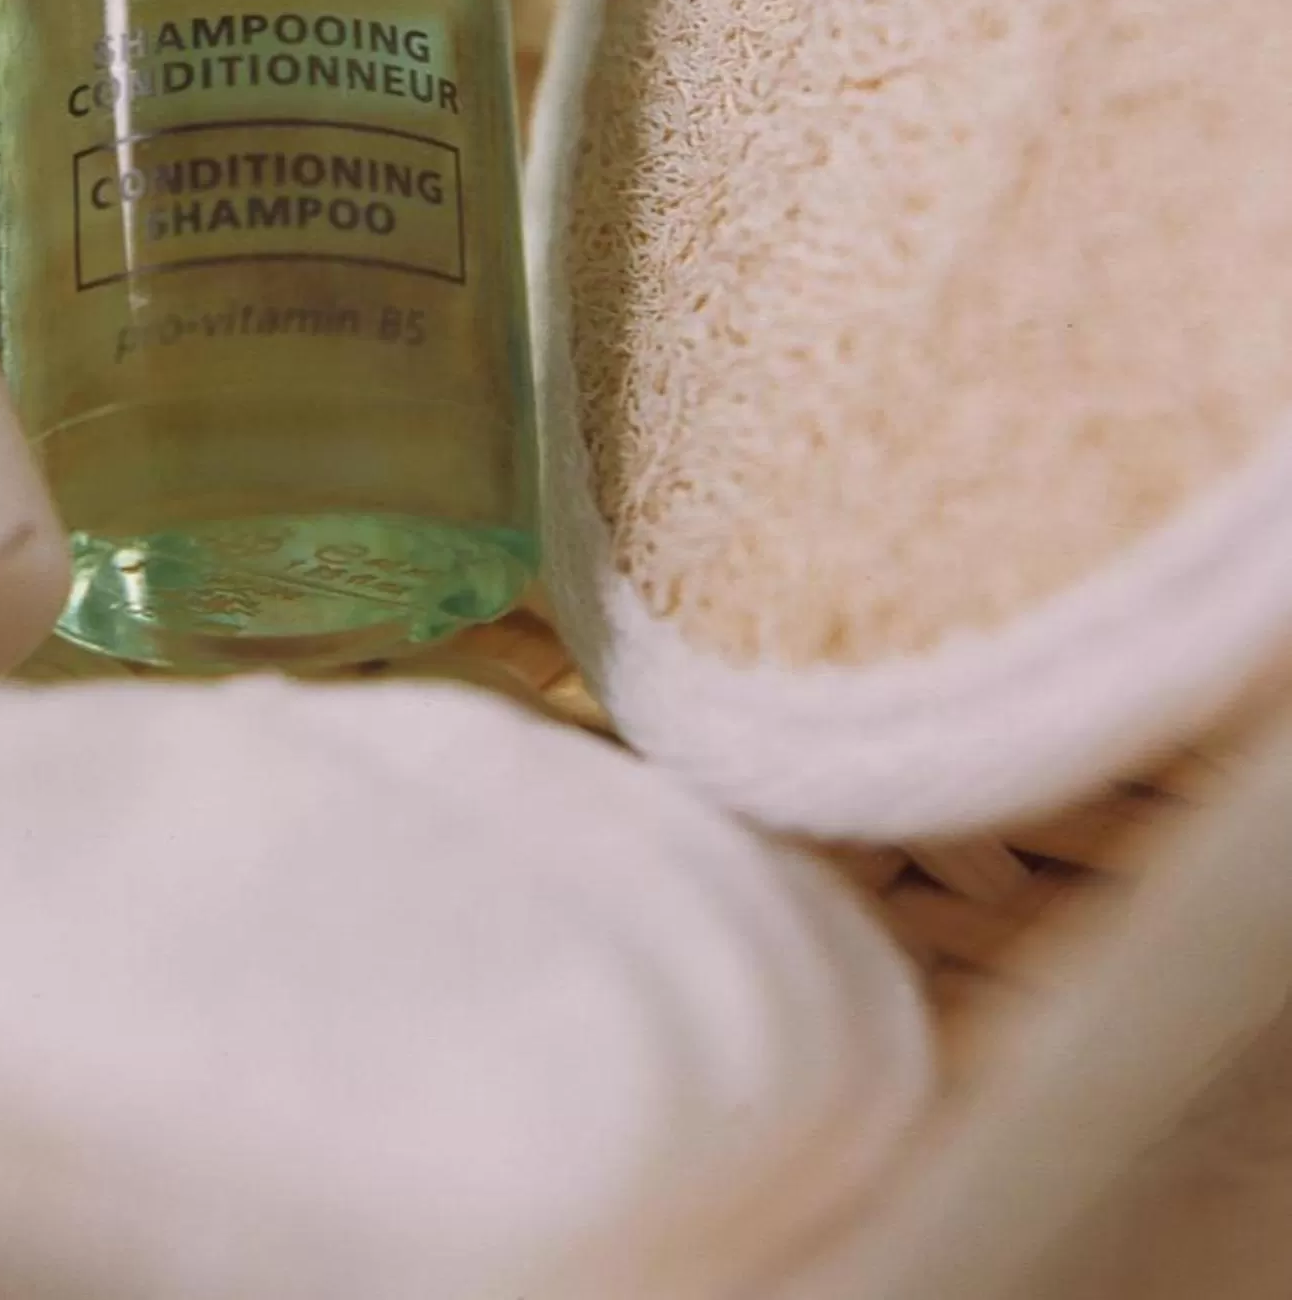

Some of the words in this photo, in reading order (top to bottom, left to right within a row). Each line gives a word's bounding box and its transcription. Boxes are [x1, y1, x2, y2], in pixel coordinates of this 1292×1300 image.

[93, 12, 432, 70] SHAMPOOING
[67, 53, 460, 118] CONDITIONNEUR
[89, 152, 446, 212] CONDITIONING
[145, 194, 397, 242] SHAMPOO
[376, 304, 427, 348] B5
